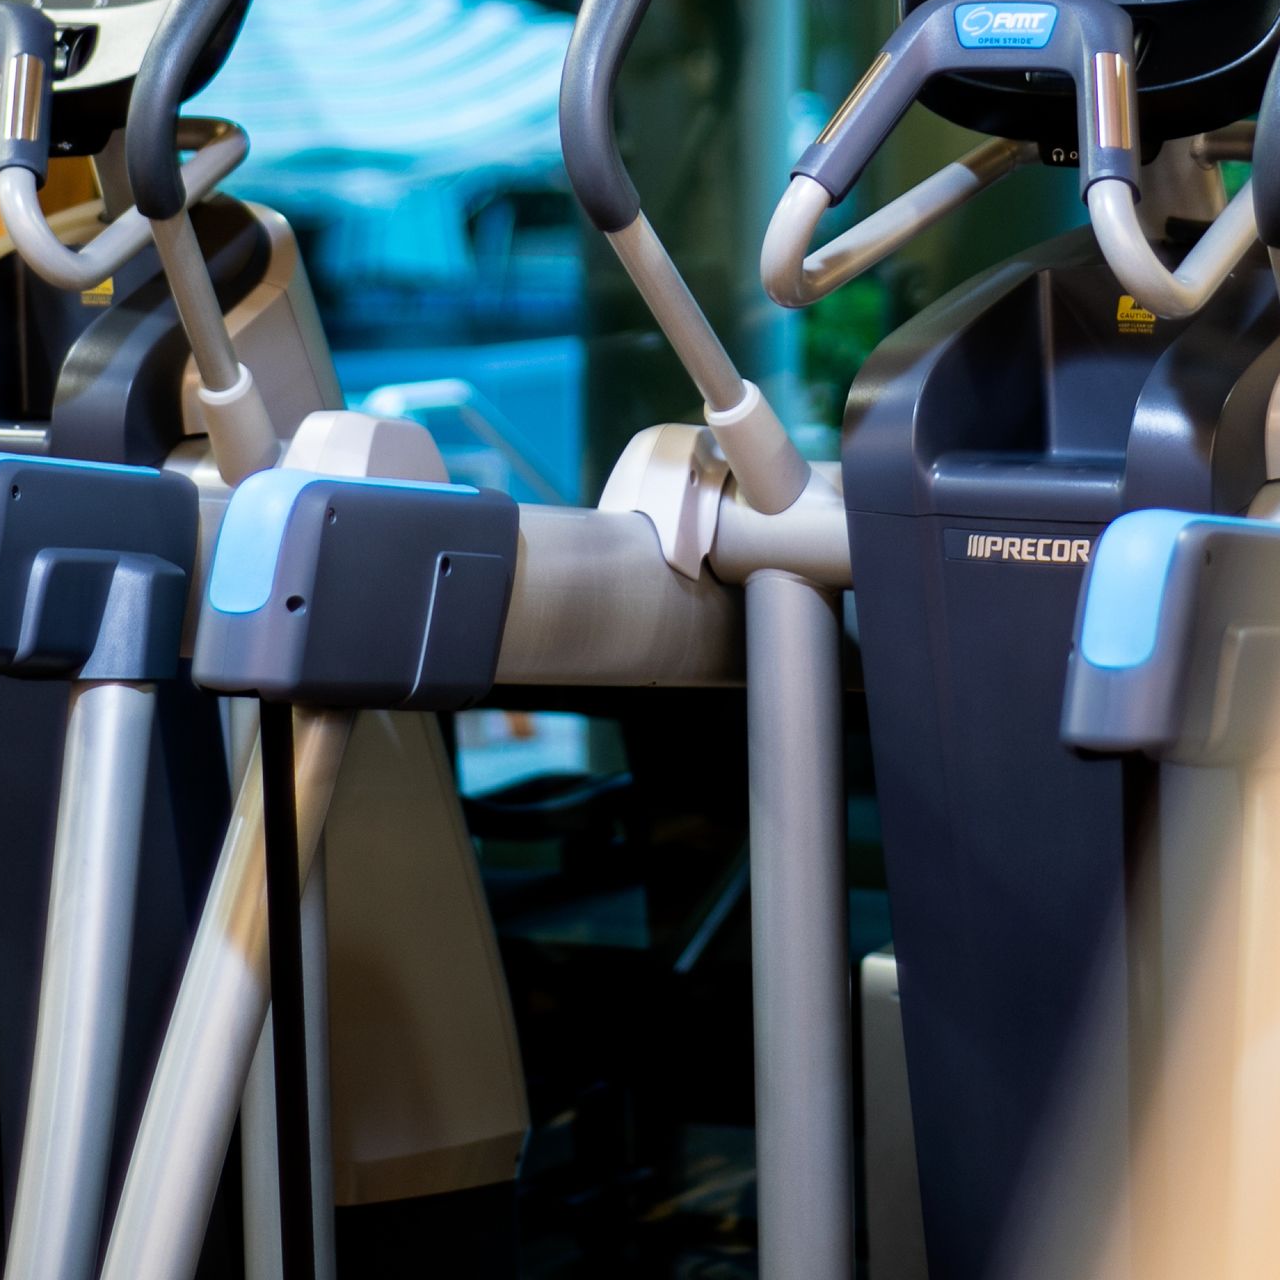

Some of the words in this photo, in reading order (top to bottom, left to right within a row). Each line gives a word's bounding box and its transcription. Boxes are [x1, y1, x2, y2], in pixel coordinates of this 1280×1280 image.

[991, 12, 1048, 29] AMT
[978, 37, 1000, 45] OPEN
[983, 536, 1090, 562] PRECOR
